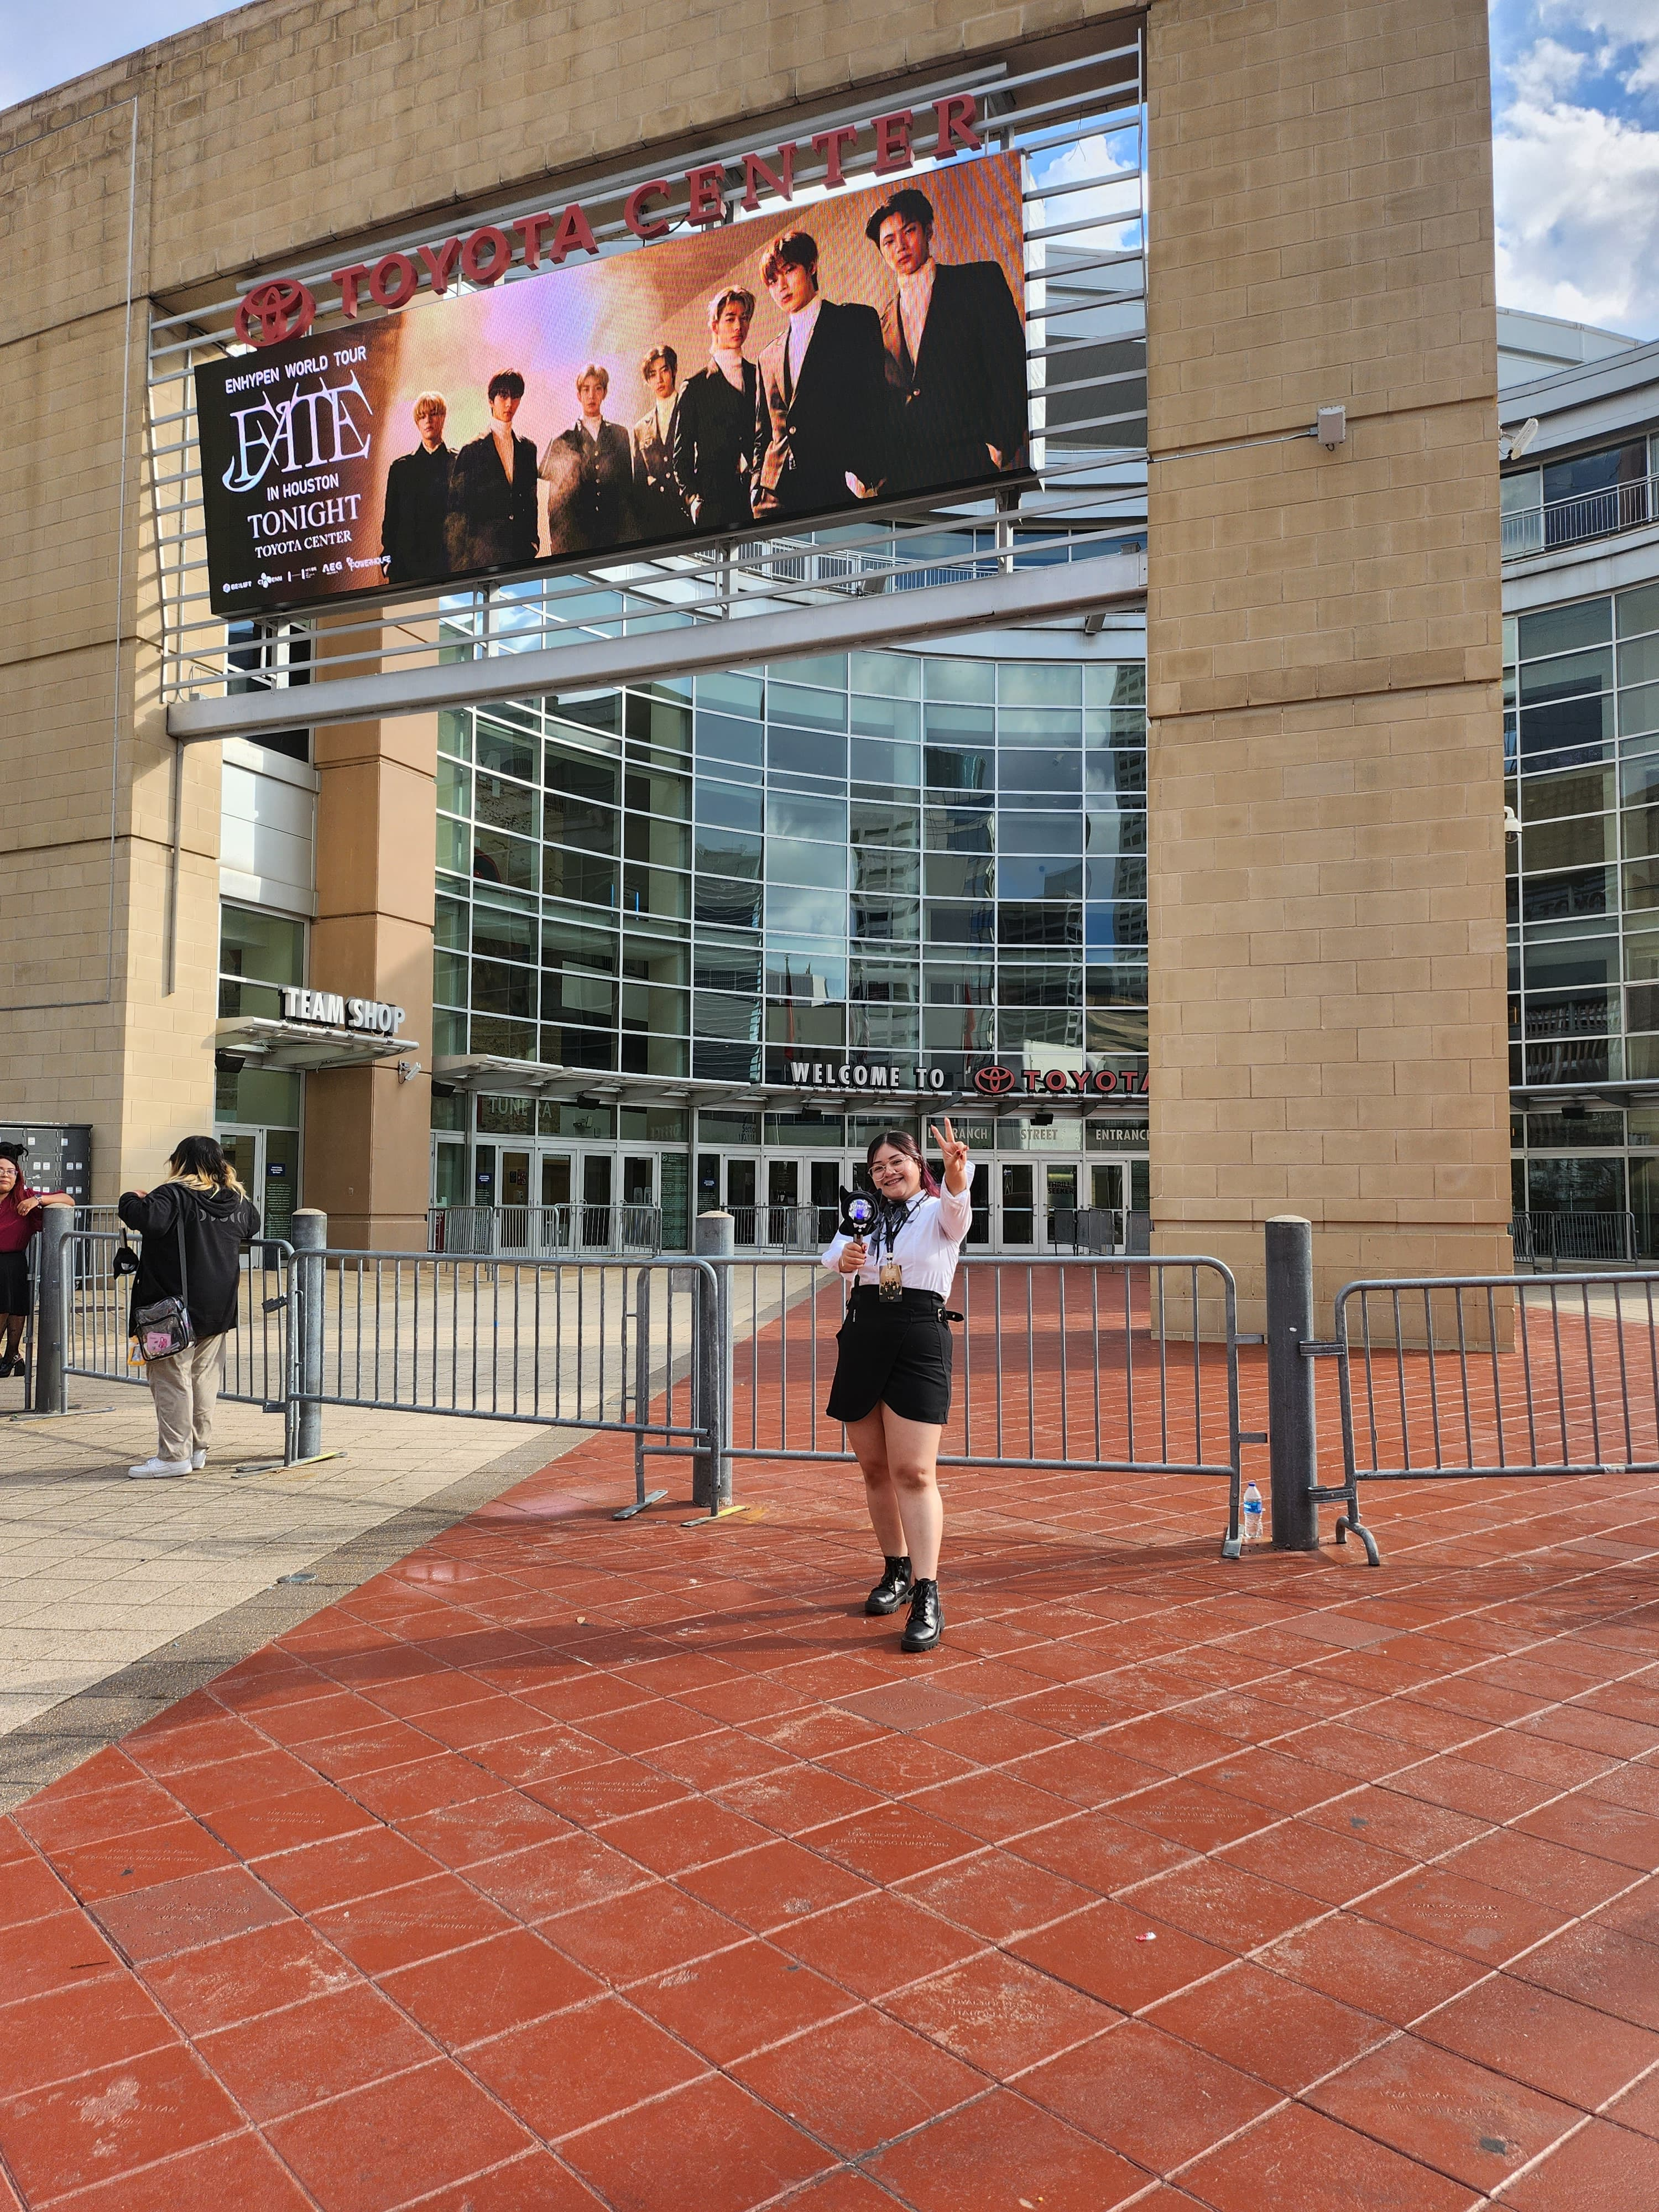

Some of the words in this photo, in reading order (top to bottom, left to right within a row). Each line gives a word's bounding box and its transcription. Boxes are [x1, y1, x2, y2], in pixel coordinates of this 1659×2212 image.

[331, 204, 599, 319] TOYOTA
[625, 93, 982, 239] CENTER
[226, 367, 279, 394] ENHYPEN
[285, 356, 328, 378] WORLD
[333, 346, 366, 366] TOUR
[267, 486, 279, 501] IN
[283, 473, 339, 498] HOUSTON
[247, 494, 361, 539] TONIGHT
[255, 543, 302, 559] TOYOTA
[304, 530, 352, 550] CENTER
[322, 561, 343, 573] AEG
[282, 987, 345, 1024] TEAM
[348, 999, 405, 1033] SHOP
[791, 1062, 899, 1088] WELCOME
[916, 1067, 944, 1088] TO
[946, 1128, 988, 1139] RANCH
[1021, 1129, 1058, 1140] STREET
